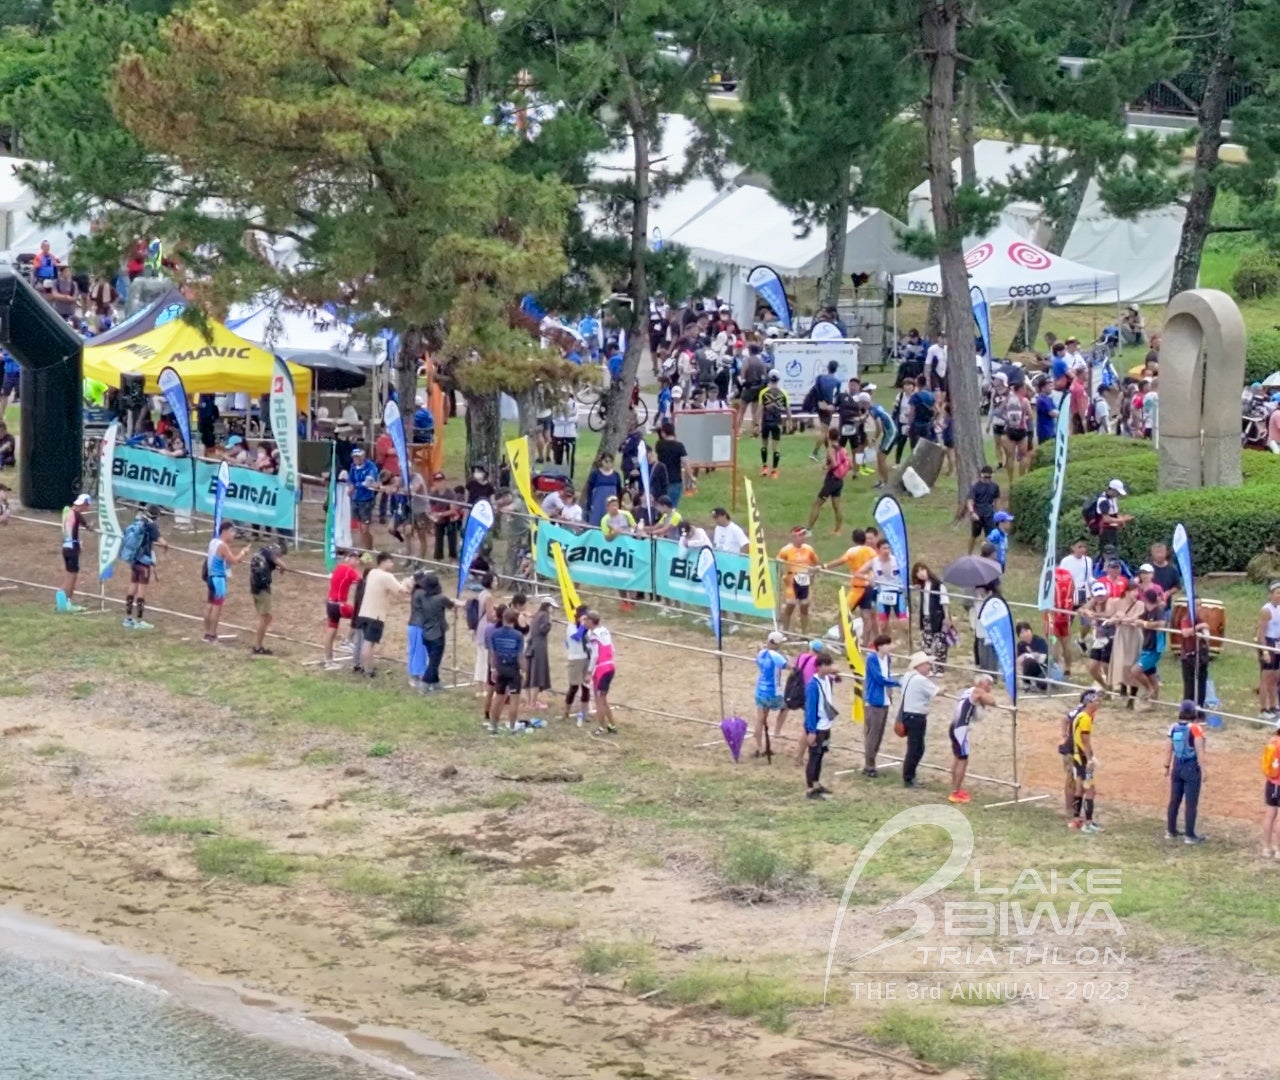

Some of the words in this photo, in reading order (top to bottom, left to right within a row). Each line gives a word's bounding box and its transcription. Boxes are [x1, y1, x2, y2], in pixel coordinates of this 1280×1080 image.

[168, 345, 251, 362] MAVIC
[112, 457, 180, 488] Bianchi
[208, 475, 279, 506] Banchi
[670, 557, 751, 592] Bich
